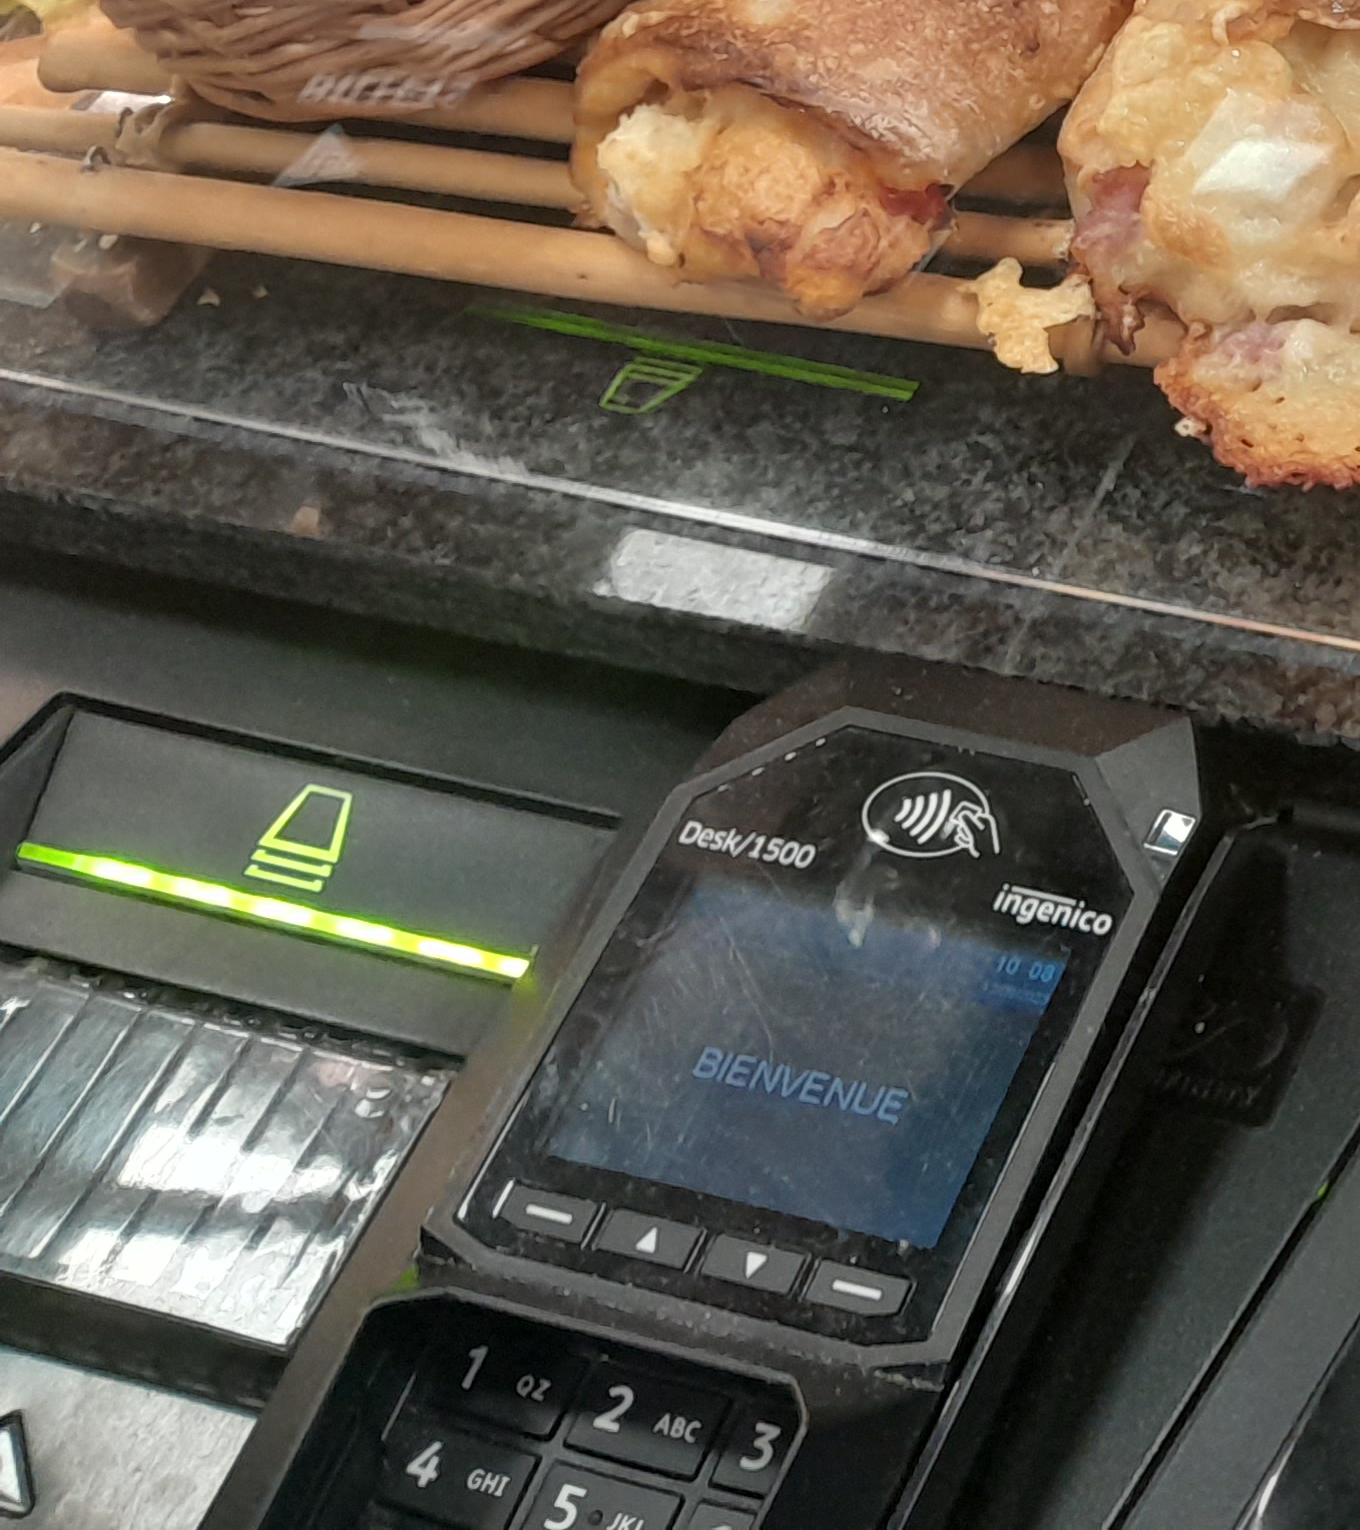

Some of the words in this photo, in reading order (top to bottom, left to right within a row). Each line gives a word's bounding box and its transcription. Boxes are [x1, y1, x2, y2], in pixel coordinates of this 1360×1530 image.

[678, 820, 816, 868] Desk/1500
[993, 883, 1113, 935] ingenico
[691, 1046, 910, 1126] BIENVENUE
[461, 1346, 488, 1390] 1
[516, 1375, 551, 1402] QZ
[592, 1385, 634, 1433] 2
[653, 1413, 702, 1444] ABC
[406, 1441, 442, 1488] 4
[467, 1468, 511, 1497] GHI
[739, 1422, 782, 1470] 3
[543, 1483, 587, 1530] 5
